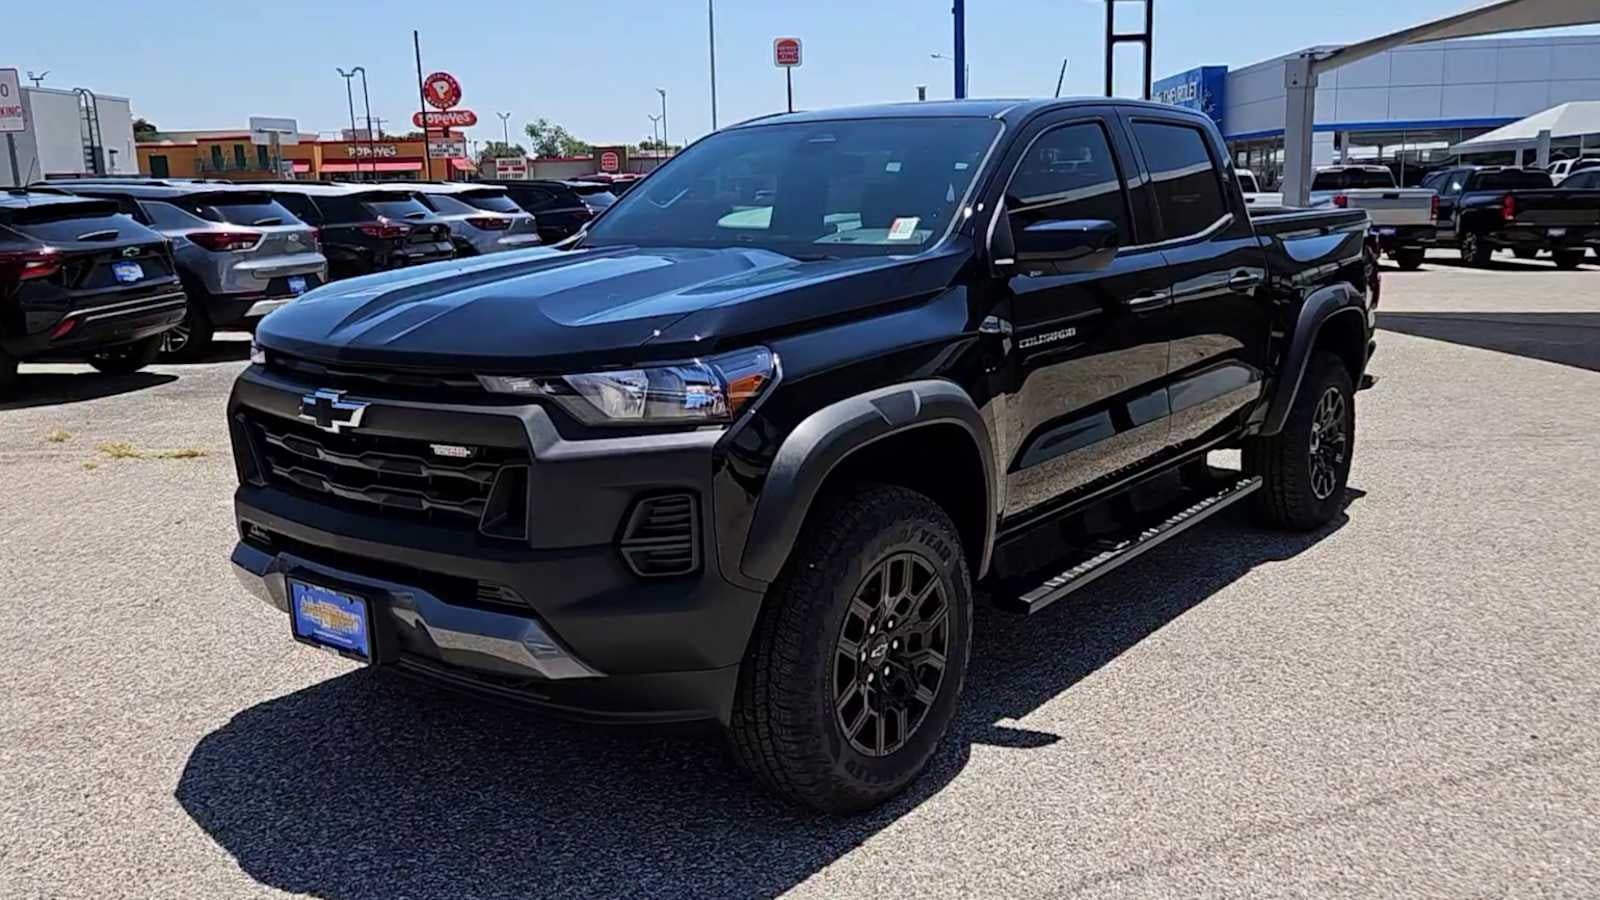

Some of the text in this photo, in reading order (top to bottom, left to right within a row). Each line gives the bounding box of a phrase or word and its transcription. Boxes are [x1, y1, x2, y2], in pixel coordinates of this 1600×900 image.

[0, 83, 8, 98] O
[0, 105, 22, 117] KING
[1018, 327, 1077, 349] COLORADO
